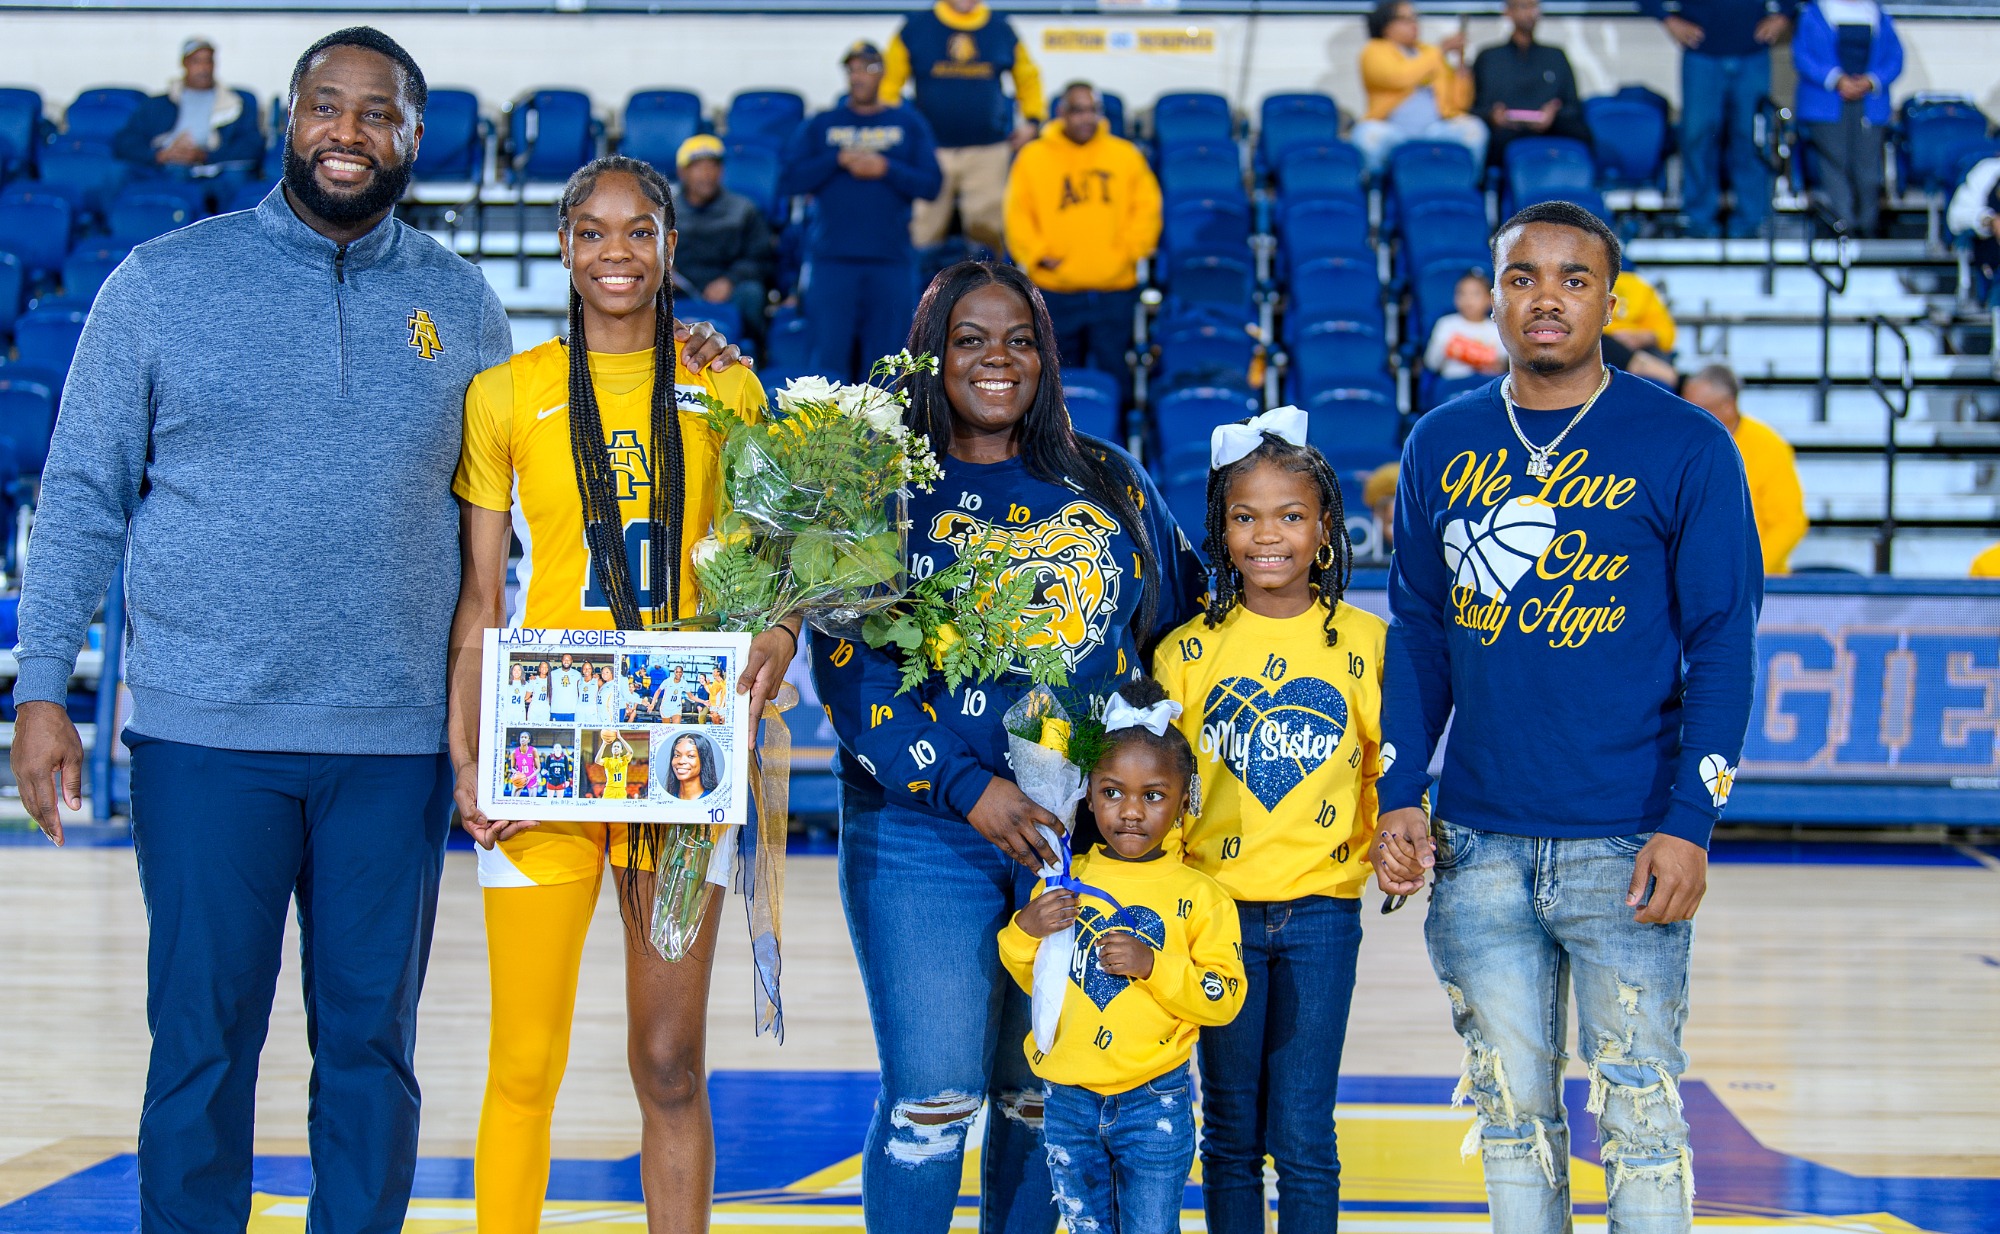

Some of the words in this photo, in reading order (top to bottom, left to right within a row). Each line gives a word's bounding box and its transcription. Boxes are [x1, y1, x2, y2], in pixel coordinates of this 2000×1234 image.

[1441, 448, 1512, 510] We
[1516, 448, 1637, 510] Love
[957, 491, 982, 511] 10
[1006, 503, 1031, 524] 10
[580, 518, 669, 611] 10
[910, 553, 934, 581] 10
[1535, 529, 1630, 581] Our
[1451, 582, 1512, 646] Lady
[1518, 584, 1626, 648] Aggie
[498, 628, 547, 644] LADY
[559, 629, 626, 646] AGGIES
[1179, 637, 1203, 662] 10
[829, 638, 854, 668] 10
[1115, 647, 1127, 676] 10
[1348, 652, 1364, 679] 10
[1260, 653, 1287, 682] 10
[511, 695, 521, 705] 24
[581, 693, 589, 703] 12
[961, 687, 987, 717] 10
[1088, 693, 1106, 721] 10
[909, 739, 937, 771] 10
[1199, 720, 1251, 770] My
[1260, 719, 1342, 761] Sister
[613, 773, 622, 782] 10
[1713, 769, 1733, 798] 10
[707, 807, 725, 823] 10
[1314, 799, 1337, 828] 10
[1220, 836, 1241, 860] 10
[1176, 898, 1193, 920] 10
[1093, 1025, 1113, 1050] 10
